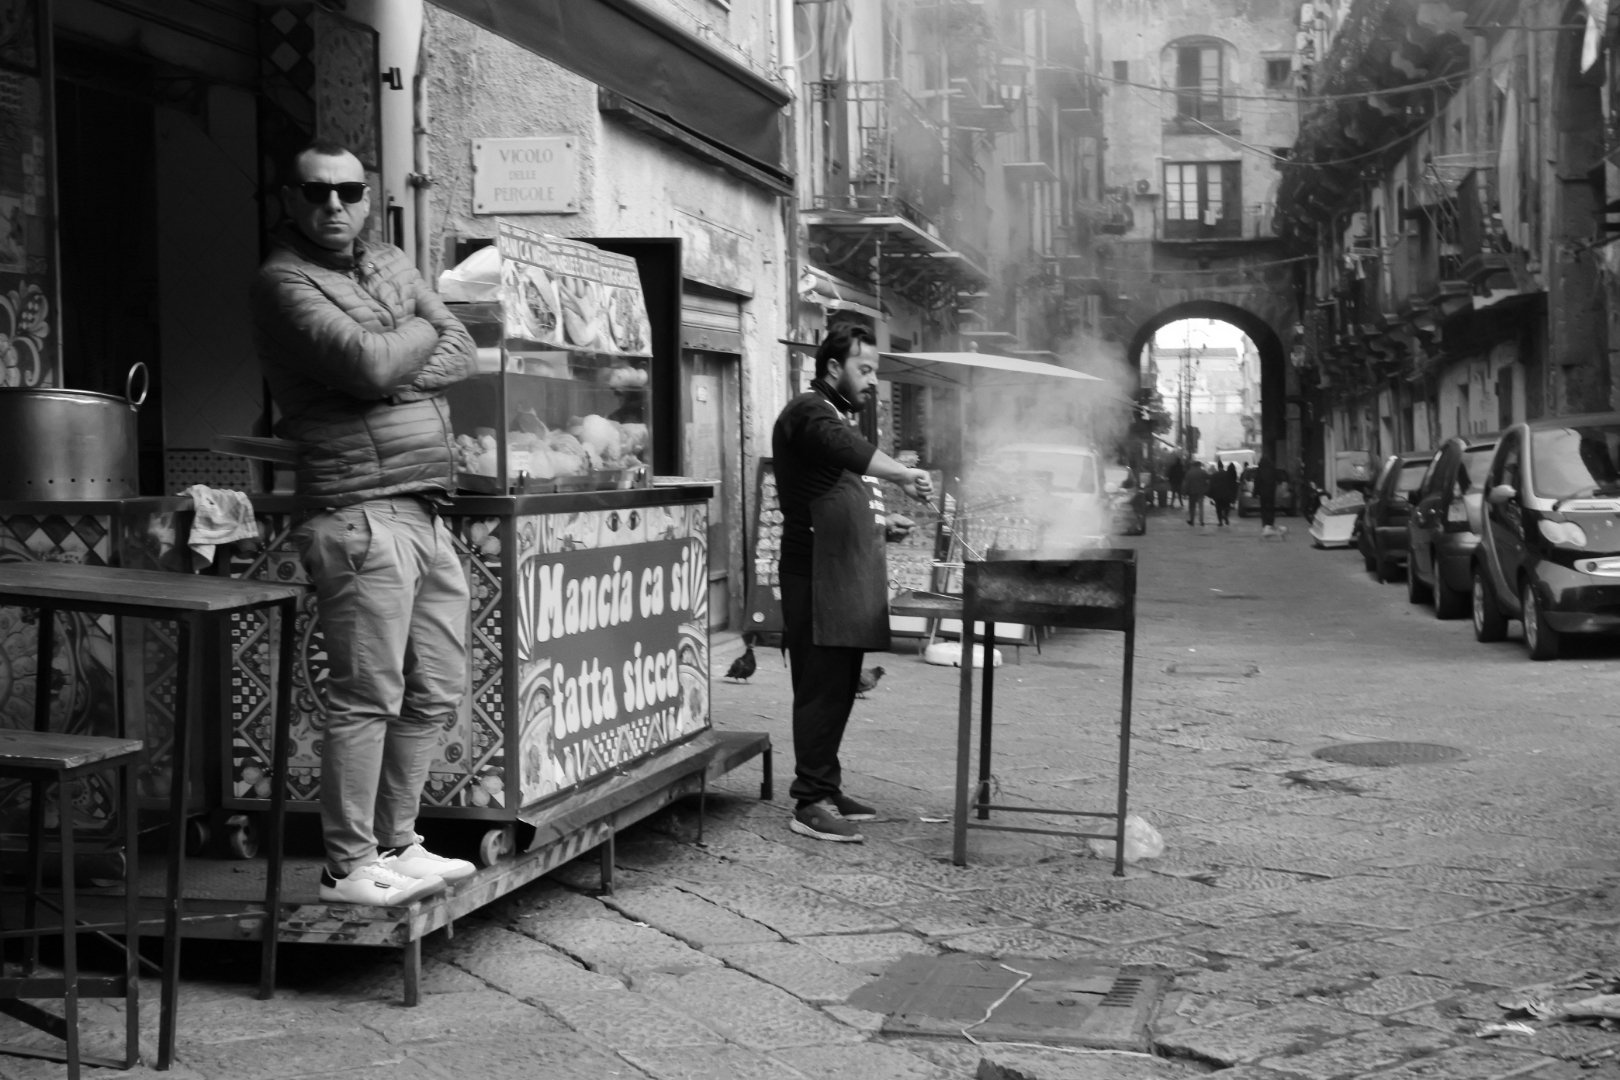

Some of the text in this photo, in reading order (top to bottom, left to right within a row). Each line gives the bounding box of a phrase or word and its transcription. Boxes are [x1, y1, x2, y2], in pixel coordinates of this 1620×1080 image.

[498, 148, 554, 164] VICOLO
[508, 170, 537, 181] DELLE
[537, 546, 690, 642] Mancia ca si
[552, 641, 679, 740] fatta sicca
